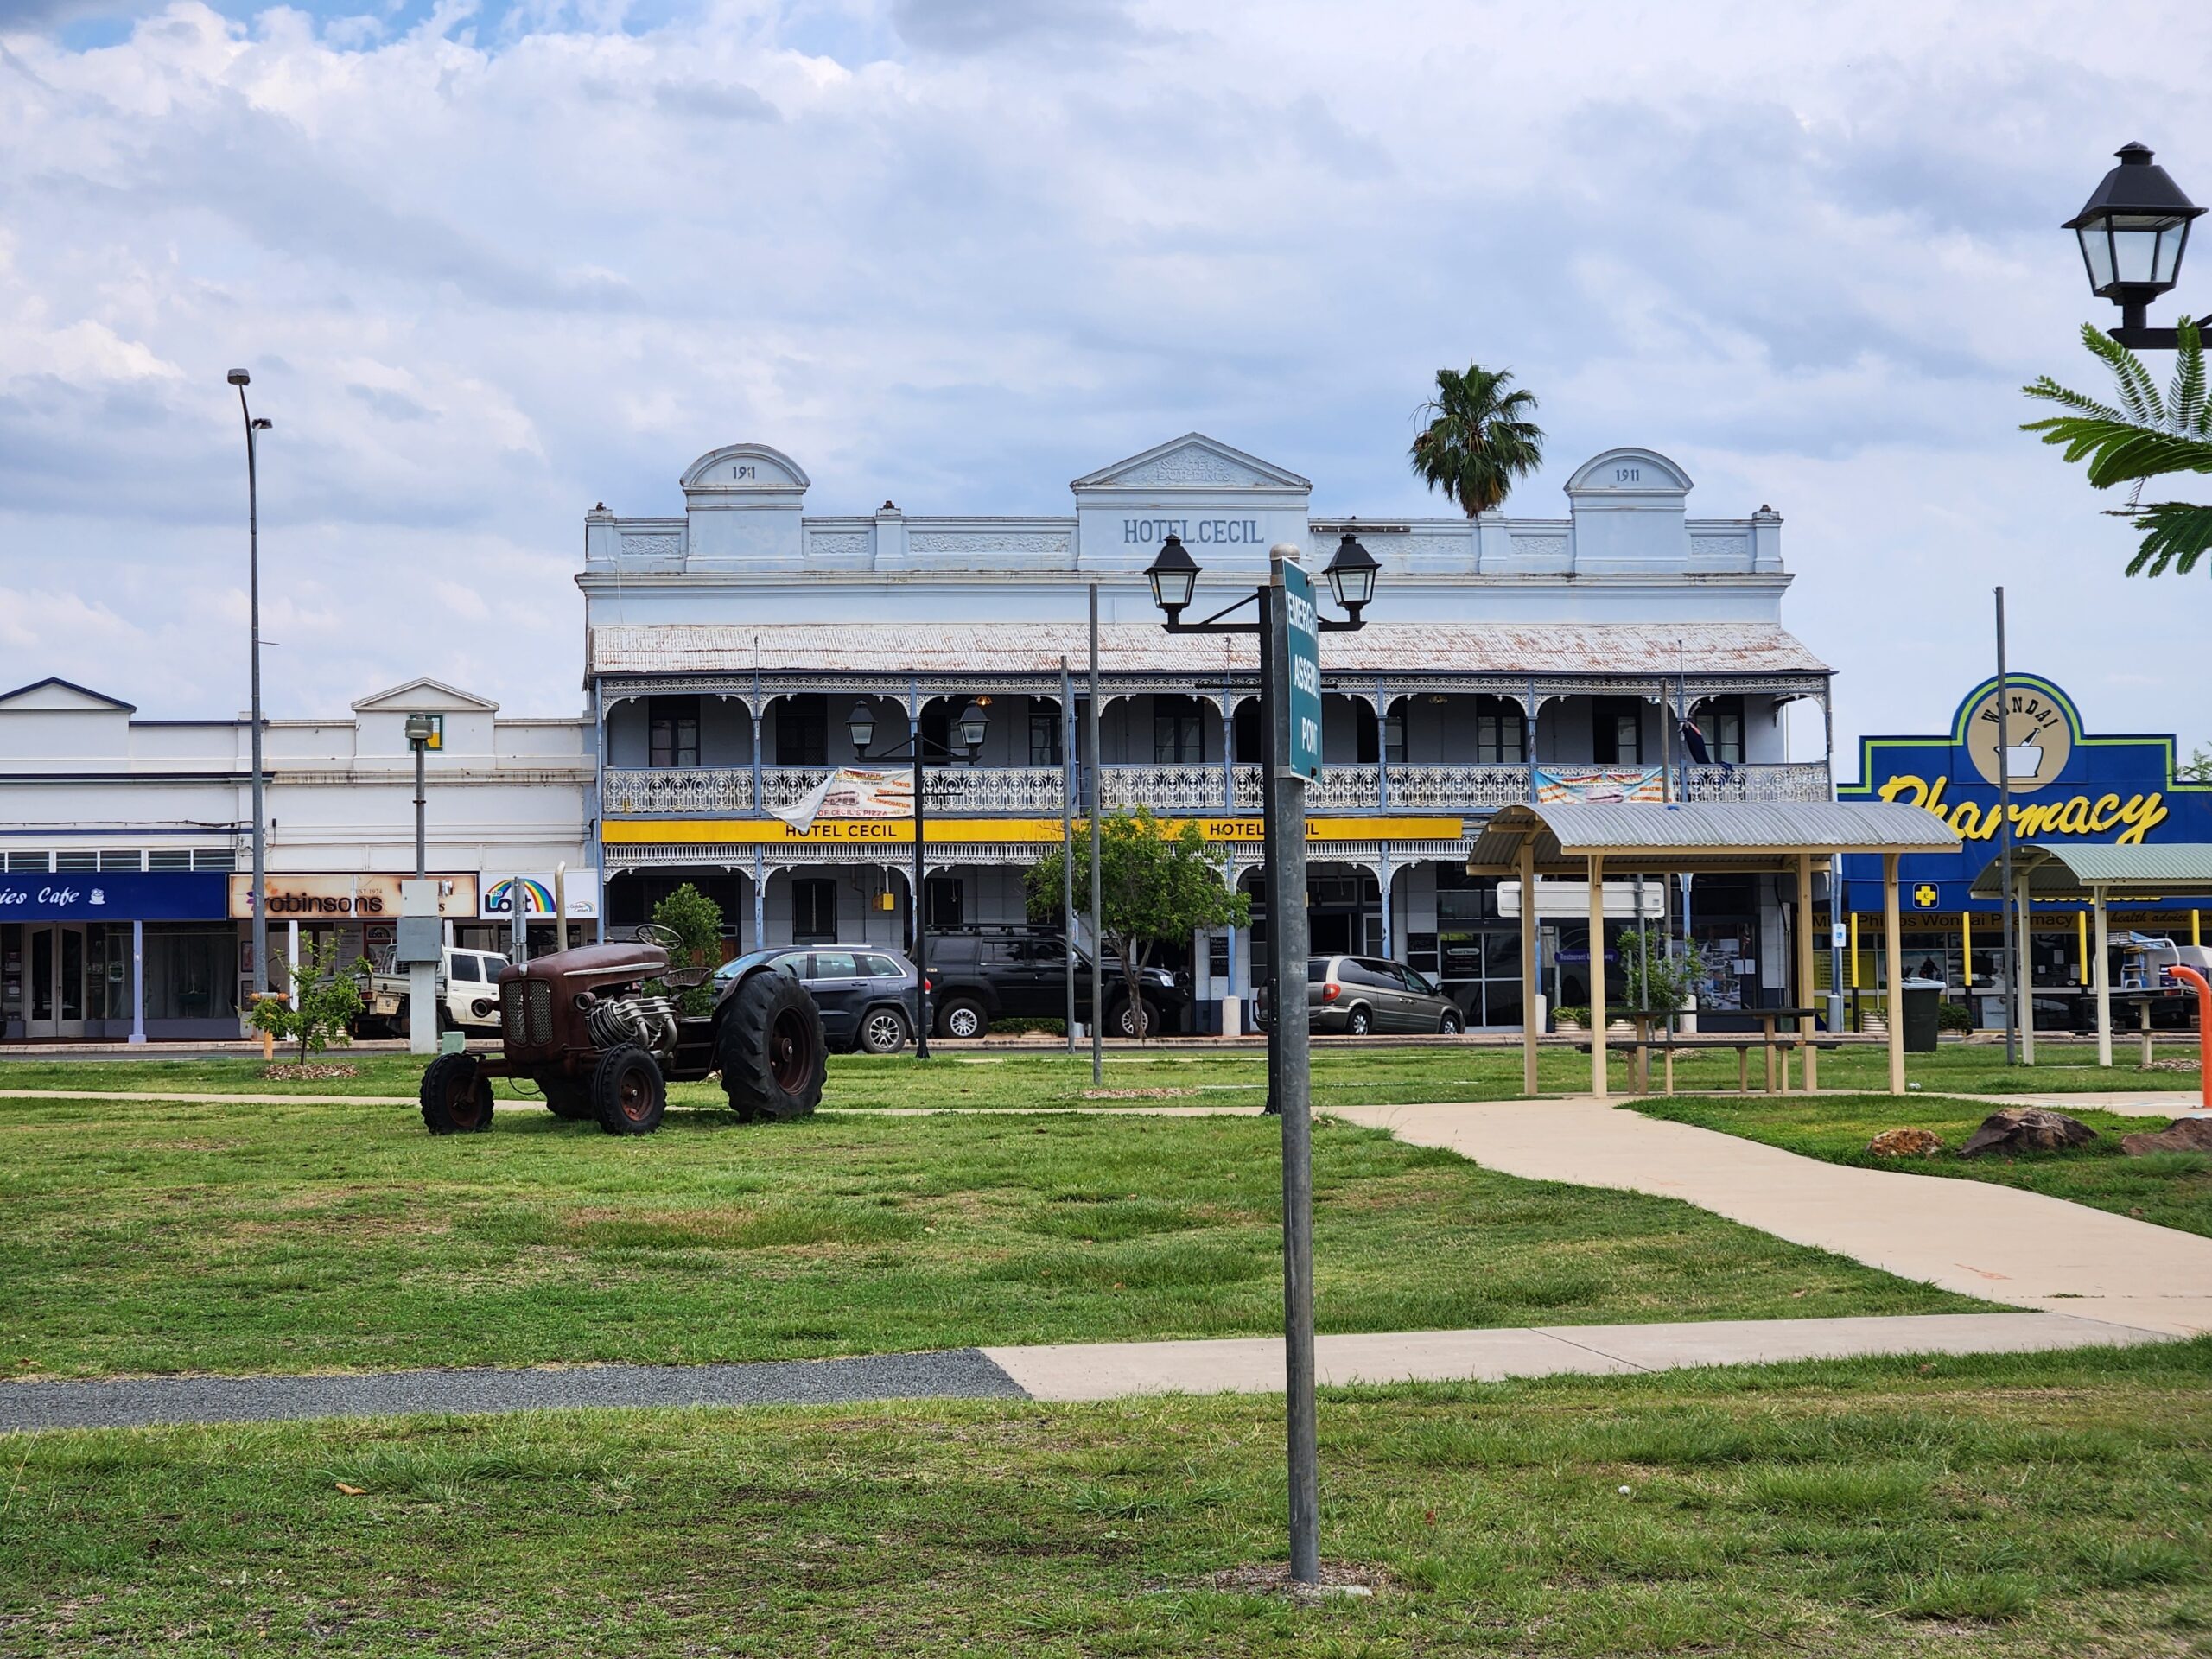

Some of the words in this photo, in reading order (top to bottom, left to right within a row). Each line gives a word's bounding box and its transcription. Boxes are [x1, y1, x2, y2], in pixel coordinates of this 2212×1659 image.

[1616, 469, 1640, 482] 1911
[848, 824, 897, 837] CECIL
[1210, 823, 1264, 836] HOTEL
[37, 887, 80, 906] Cafe
[485, 893, 531, 913] Lot
[1813, 915, 1851, 927] Mie
[1991, 913, 2073, 928] Pamacy
